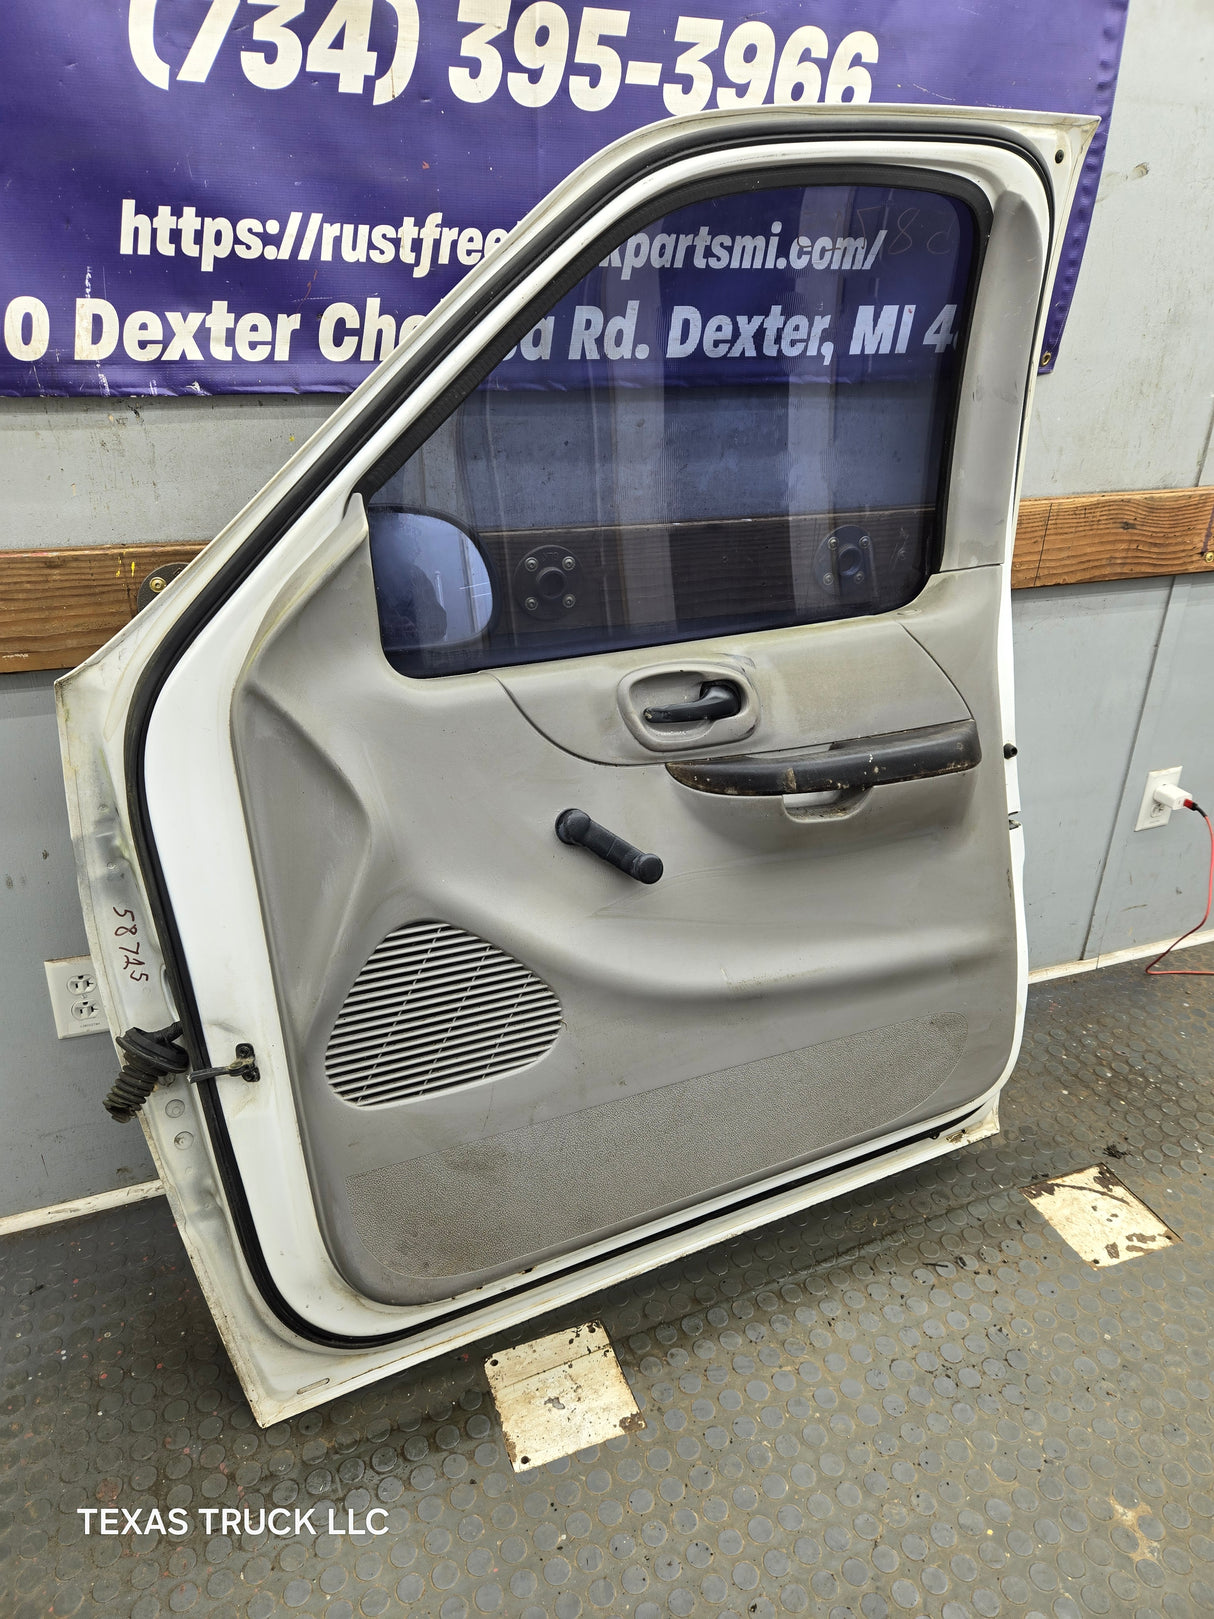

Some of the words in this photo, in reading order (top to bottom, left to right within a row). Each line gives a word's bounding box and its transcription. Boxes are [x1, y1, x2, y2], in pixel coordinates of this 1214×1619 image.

[448, 0, 879, 116] 395-3966
[74, 297, 301, 362] Dexter
[568, 300, 650, 360] Rd.
[665, 305, 833, 366] Dexter,
[849, 305, 917, 355] MI
[112, 906, 149, 982] 58715
